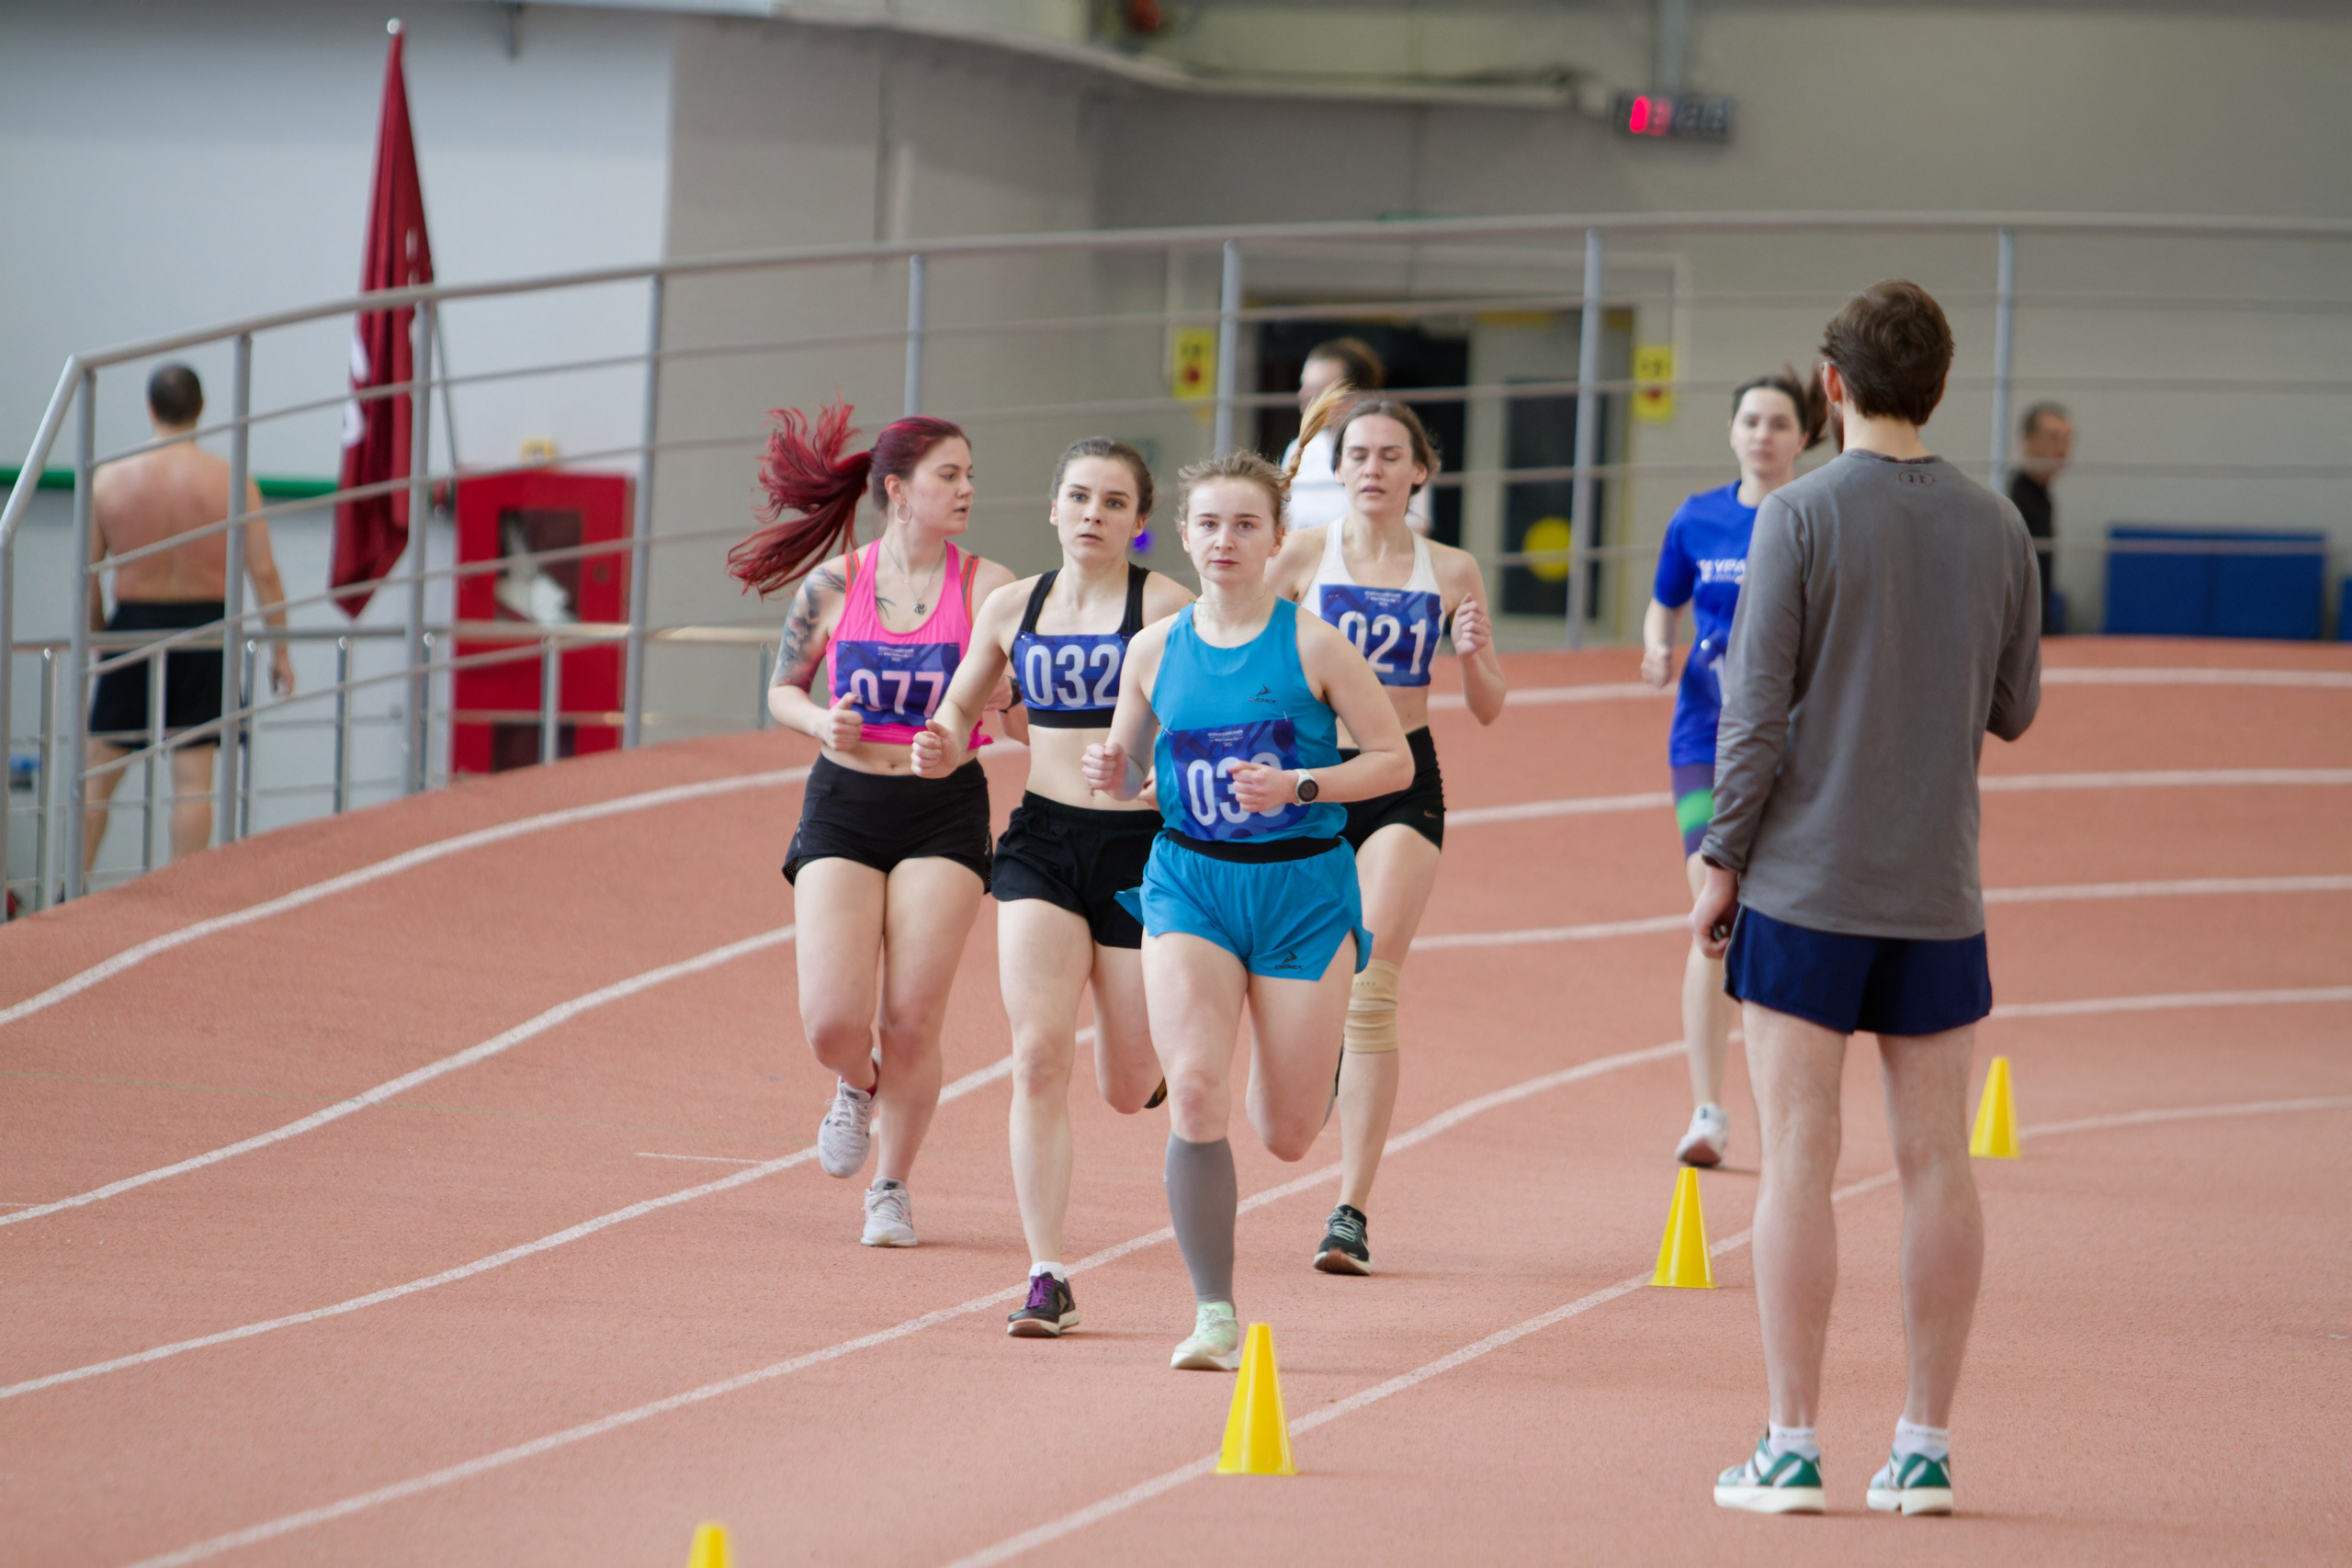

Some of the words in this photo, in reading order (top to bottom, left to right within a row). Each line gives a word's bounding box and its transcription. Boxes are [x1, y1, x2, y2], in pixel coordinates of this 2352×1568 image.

[1338, 610, 1426, 675] 021
[850, 668, 944, 718] 077
[1024, 644, 1120, 708] 032
